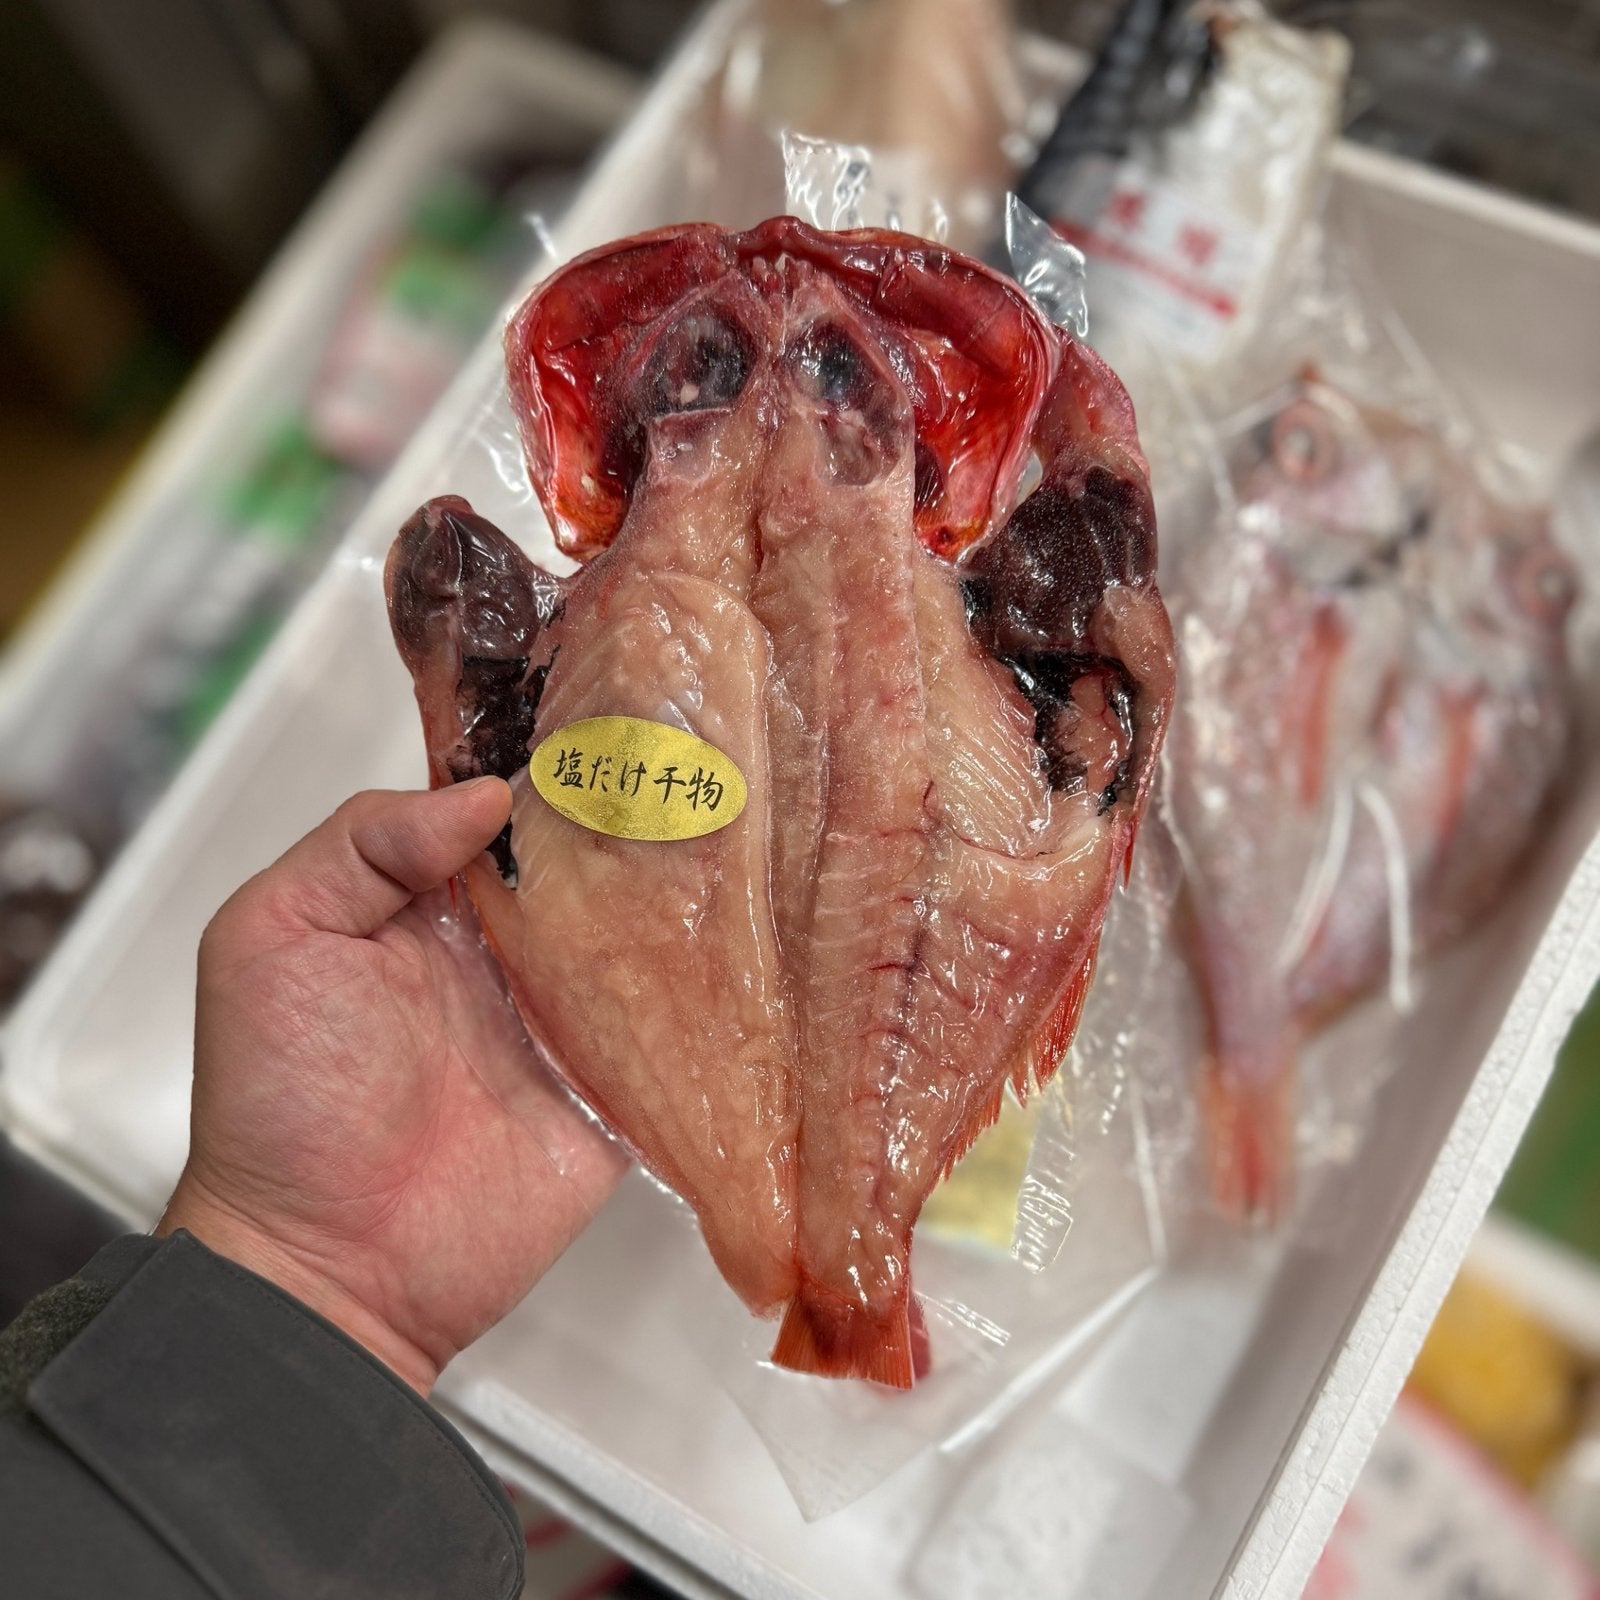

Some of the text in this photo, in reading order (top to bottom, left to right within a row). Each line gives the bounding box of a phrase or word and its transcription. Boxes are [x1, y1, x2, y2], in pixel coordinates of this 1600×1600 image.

[553, 747, 724, 811] 塩だけ干物
